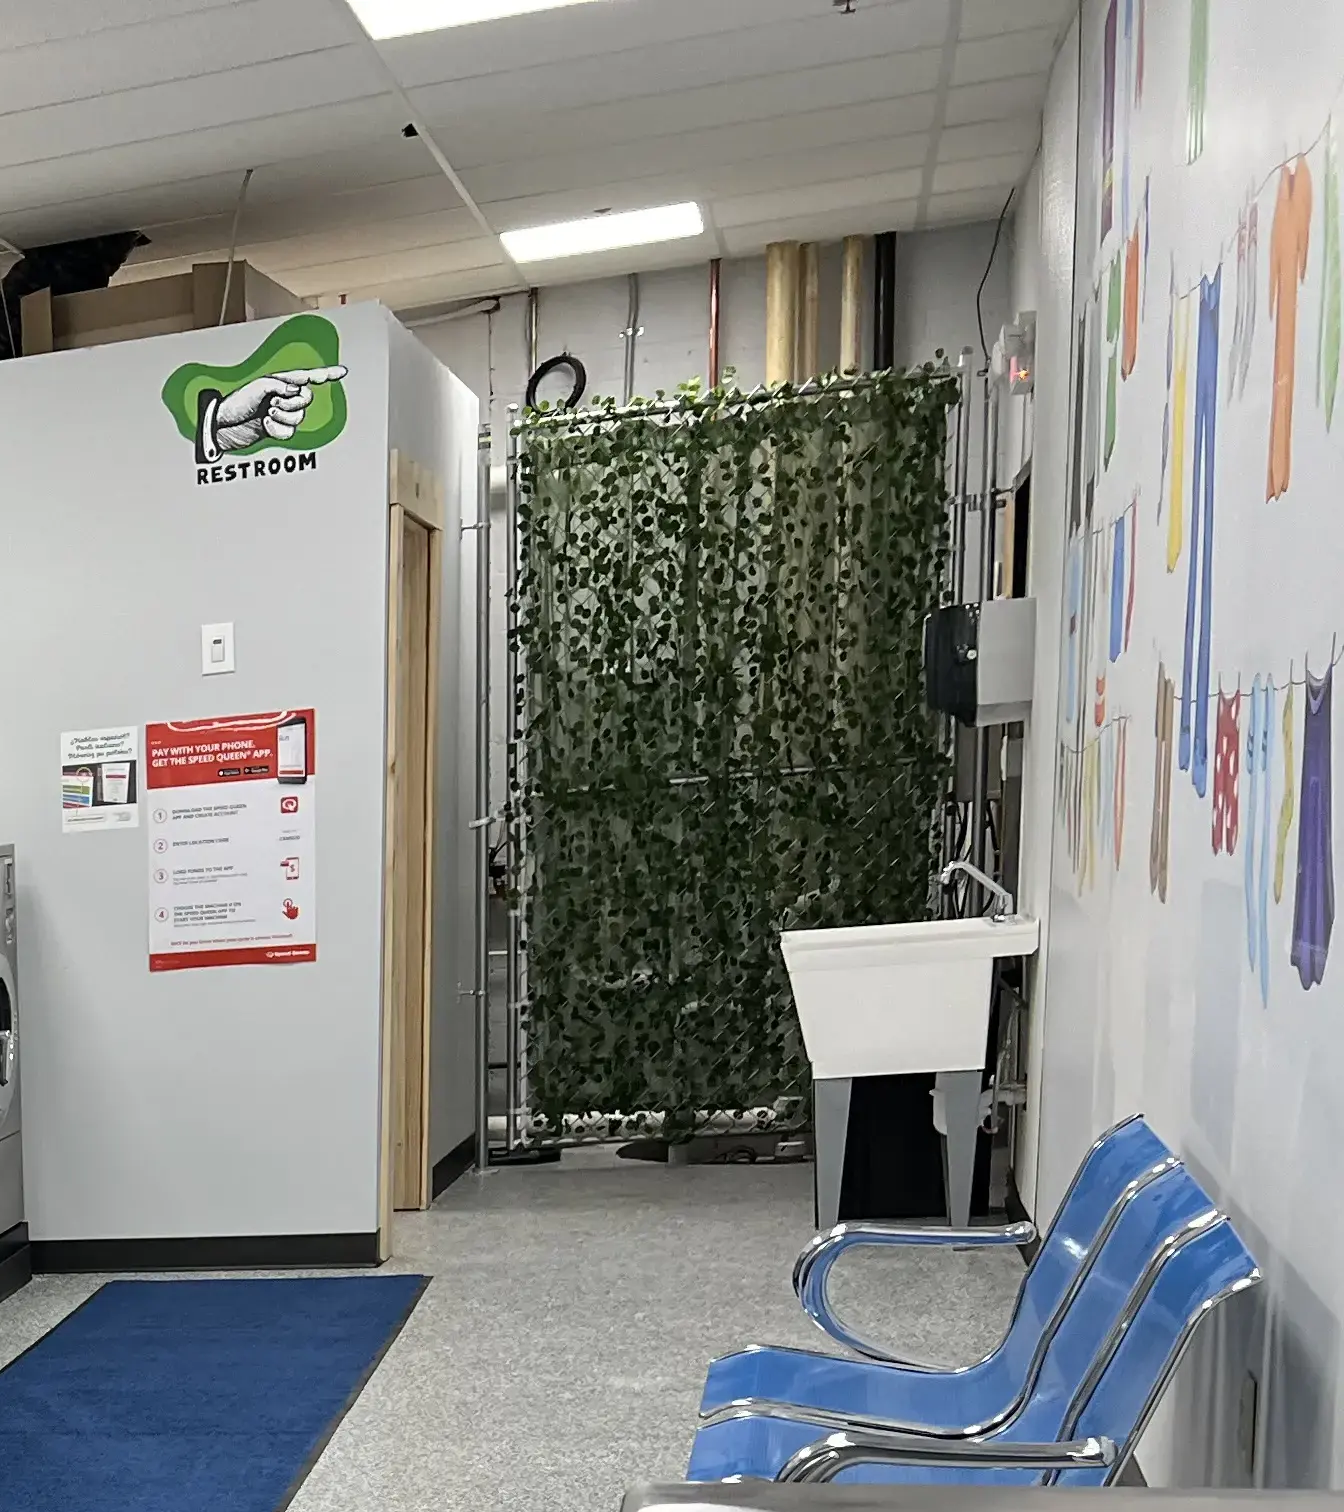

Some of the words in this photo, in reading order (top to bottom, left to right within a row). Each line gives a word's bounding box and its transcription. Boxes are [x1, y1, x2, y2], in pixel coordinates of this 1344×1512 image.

[196, 451, 318, 485] RESTROOM
[151, 748, 169, 758] PAY
[170, 746, 194, 755] WITH
[195, 743, 220, 753] YOUR
[221, 740, 256, 751] PHONE.
[152, 758, 170, 767] GET
[171, 756, 187, 765] THE
[188, 754, 215, 764] SPEED
[253, 749, 273, 758] APP.
[158, 812, 162, 820] 1
[157, 842, 163, 850] 2
[158, 872, 163, 880] 3
